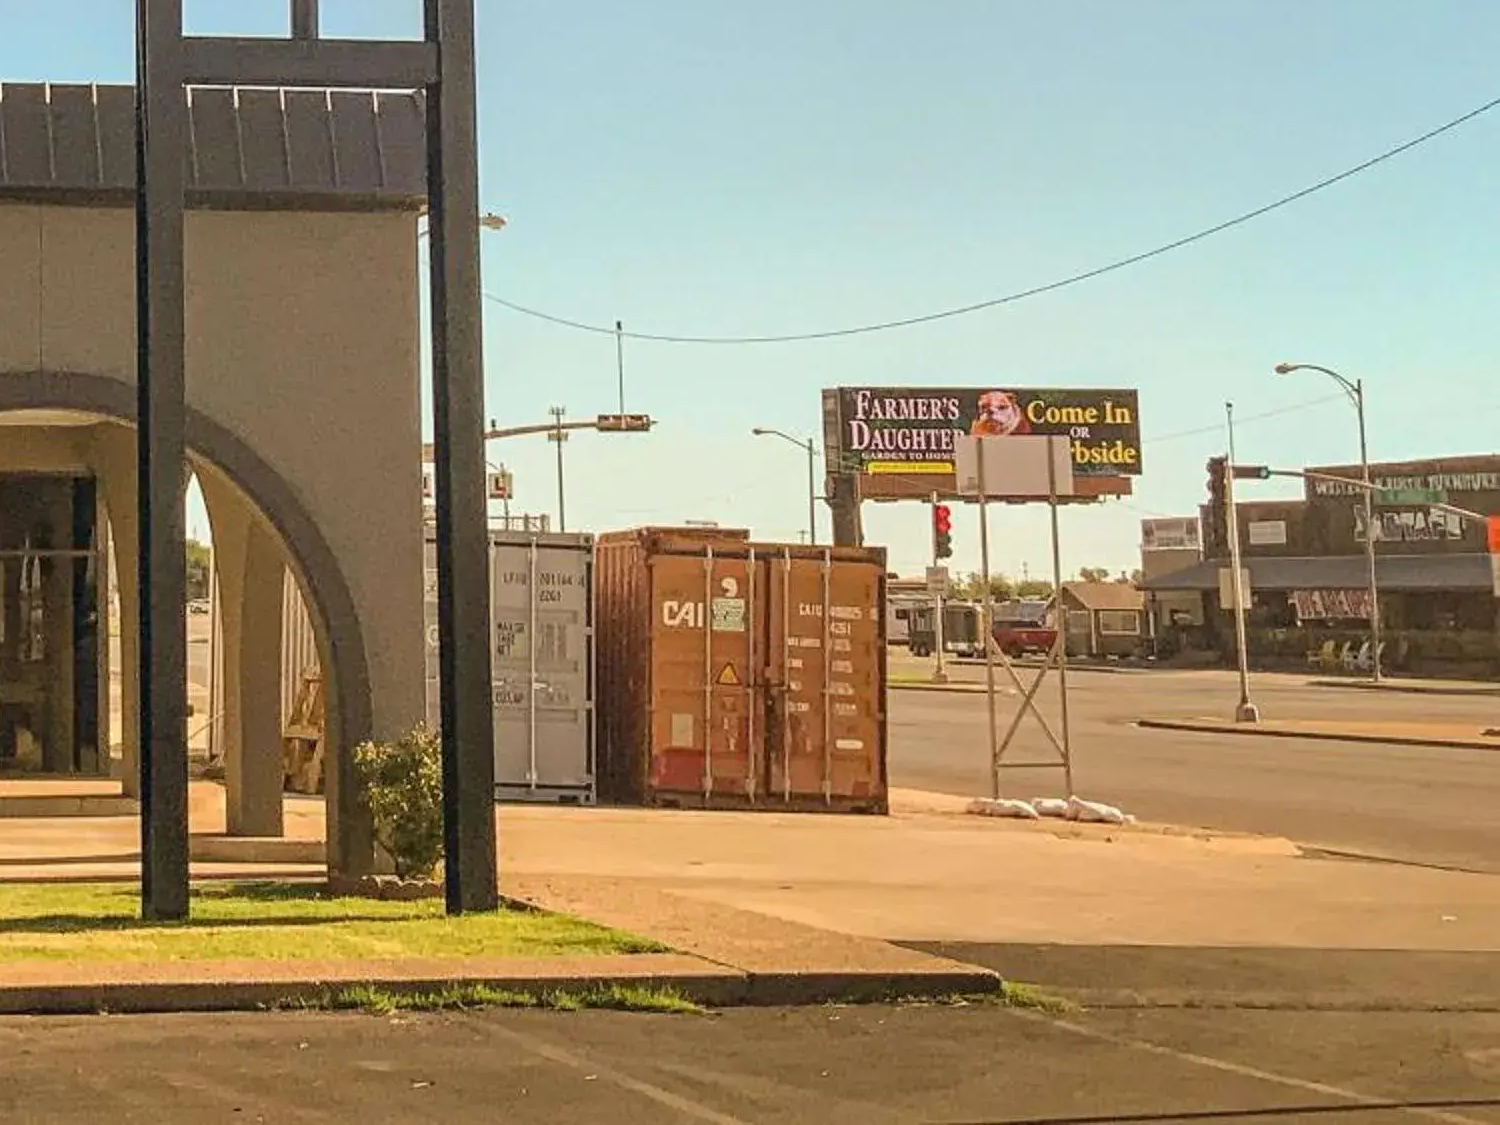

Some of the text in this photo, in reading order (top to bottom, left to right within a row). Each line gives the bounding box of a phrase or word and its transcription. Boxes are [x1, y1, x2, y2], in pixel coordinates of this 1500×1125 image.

[855, 390, 960, 420] FARMER'S
[1027, 400, 1132, 424] Come In
[1070, 426, 1091, 438] OR
[663, 600, 704, 627] CAI
